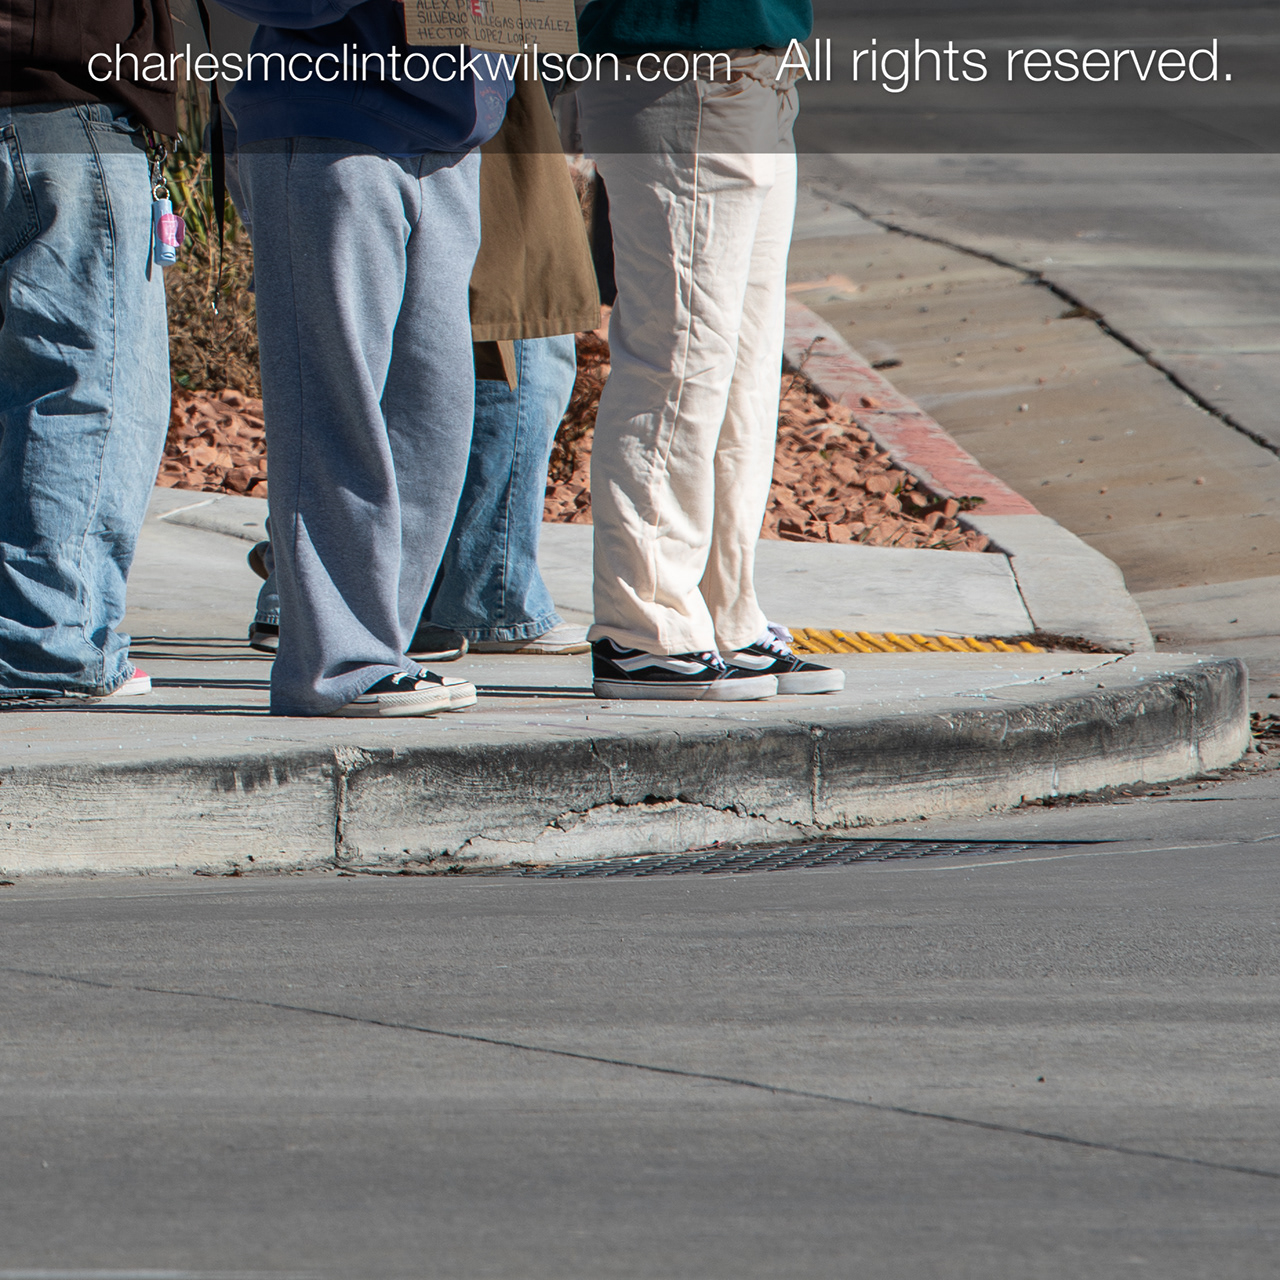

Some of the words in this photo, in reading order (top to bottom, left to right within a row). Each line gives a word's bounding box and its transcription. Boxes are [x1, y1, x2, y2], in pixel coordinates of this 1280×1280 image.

[417, 11, 468, 24] SILVERIO
[417, 27, 471, 40] HECTOR
[474, 27, 506, 45] LOPEZ
